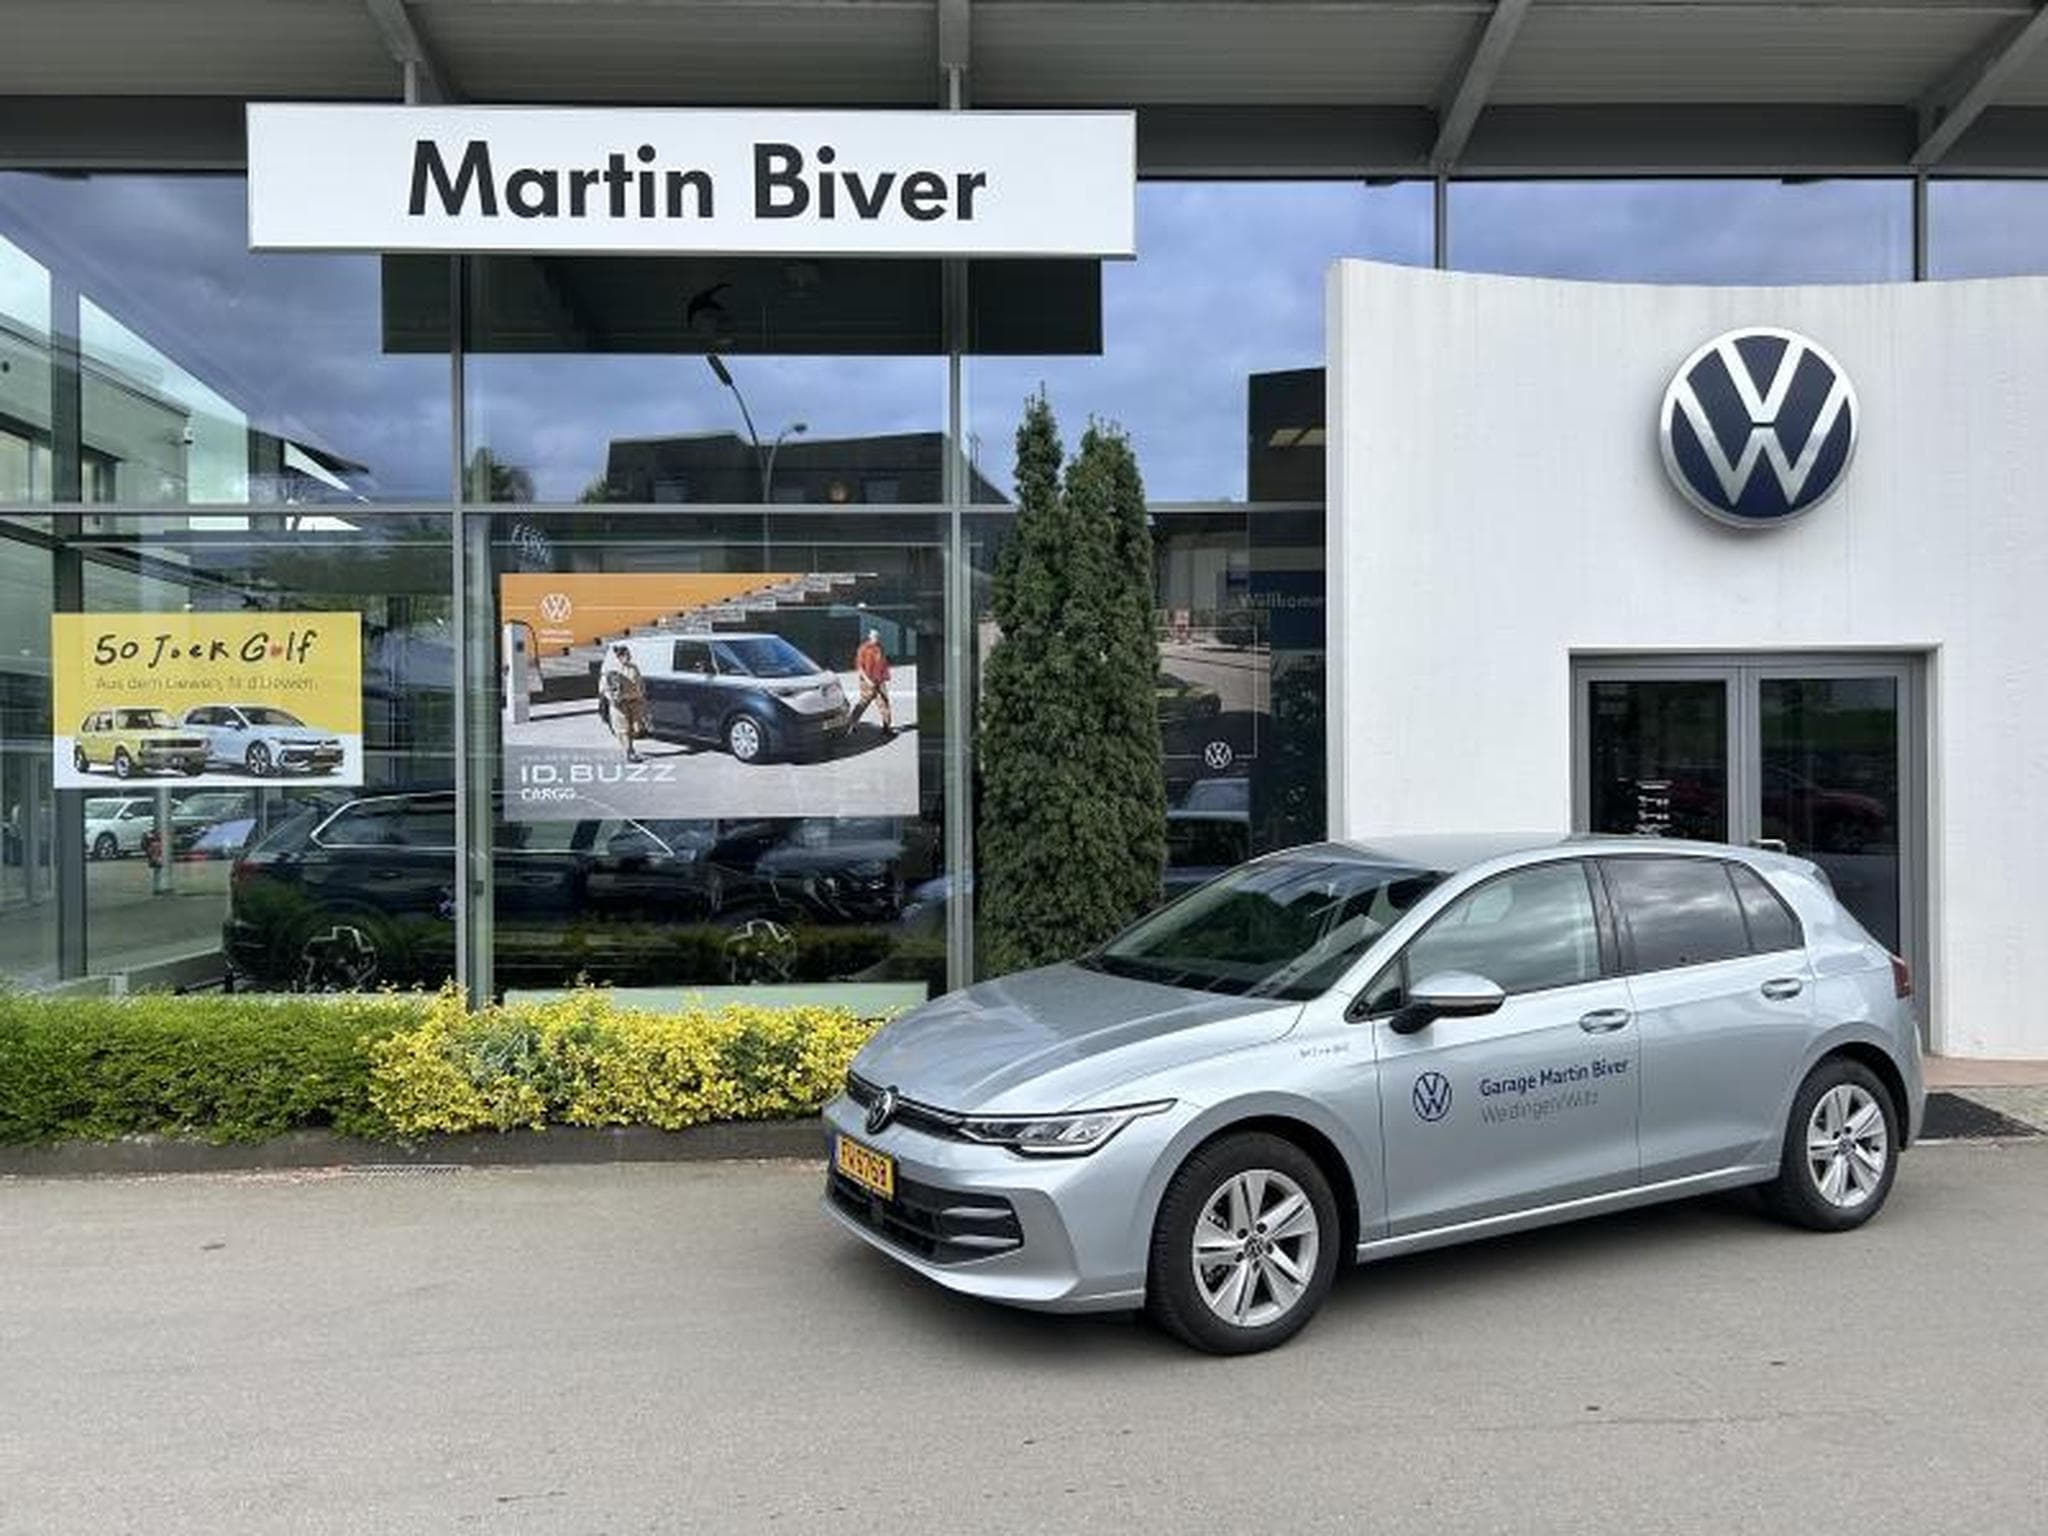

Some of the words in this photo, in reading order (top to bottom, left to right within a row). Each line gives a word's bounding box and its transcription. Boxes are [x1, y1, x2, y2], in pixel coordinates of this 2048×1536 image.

[407, 139, 713, 220] Martin
[753, 142, 987, 221] Biver
[94, 634, 139, 666] 50
[521, 787, 577, 801] CARGO
[1480, 1074, 1537, 1097] Garage
[1540, 1065, 1588, 1087] Martin
[1592, 1058, 1630, 1079] Biver
